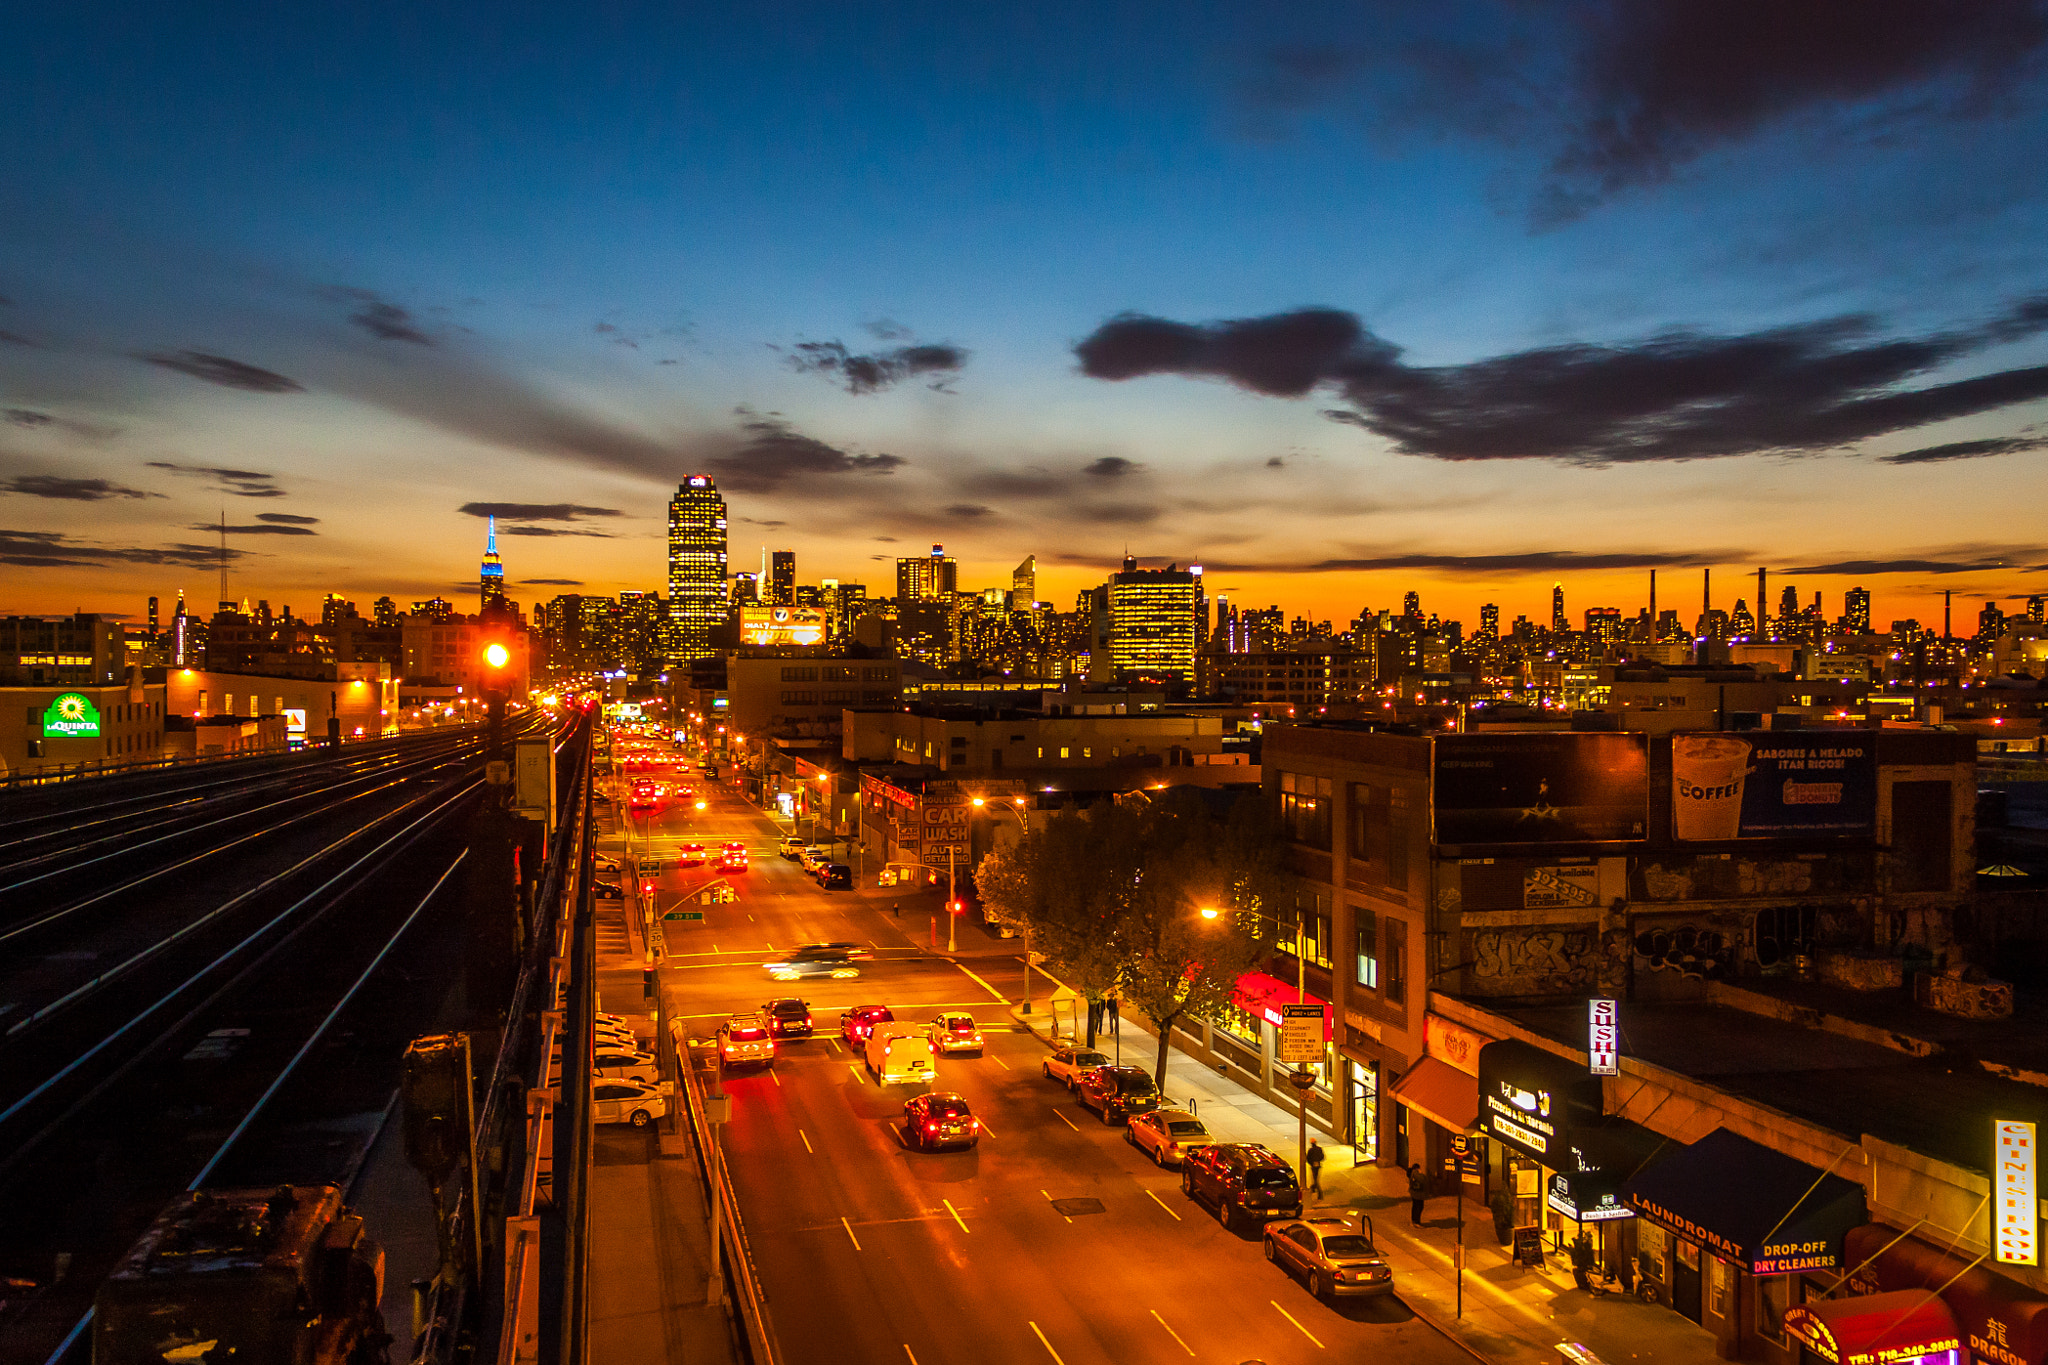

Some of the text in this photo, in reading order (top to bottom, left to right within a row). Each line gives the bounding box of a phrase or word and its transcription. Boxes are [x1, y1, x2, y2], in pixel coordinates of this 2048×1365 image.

[1757, 748, 1863, 759] SABORES A HELADO
[1461, 760, 1494, 768] WALKING
[1680, 782, 1740, 800] COFFEE
[924, 807, 968, 824] CAR
[925, 827, 968, 841] WASH
[924, 855, 969, 863] DETAING
[1556, 868, 1595, 877] Available
[1531, 869, 1595, 905] 392-5959
[1595, 1002, 1612, 1066] SUSHI
[1488, 1095, 1512, 1117] Pizzeria
[1633, 1193, 1742, 1257] LAUNDROMAT
[1764, 1241, 1827, 1256] DROP-OFF
[1754, 1255, 1836, 1273] DRY CLEANERS
[1785, 1309, 1838, 1351] GREAT DRAGON
[1784, 1323, 1839, 1364] CHINESE FOOD
